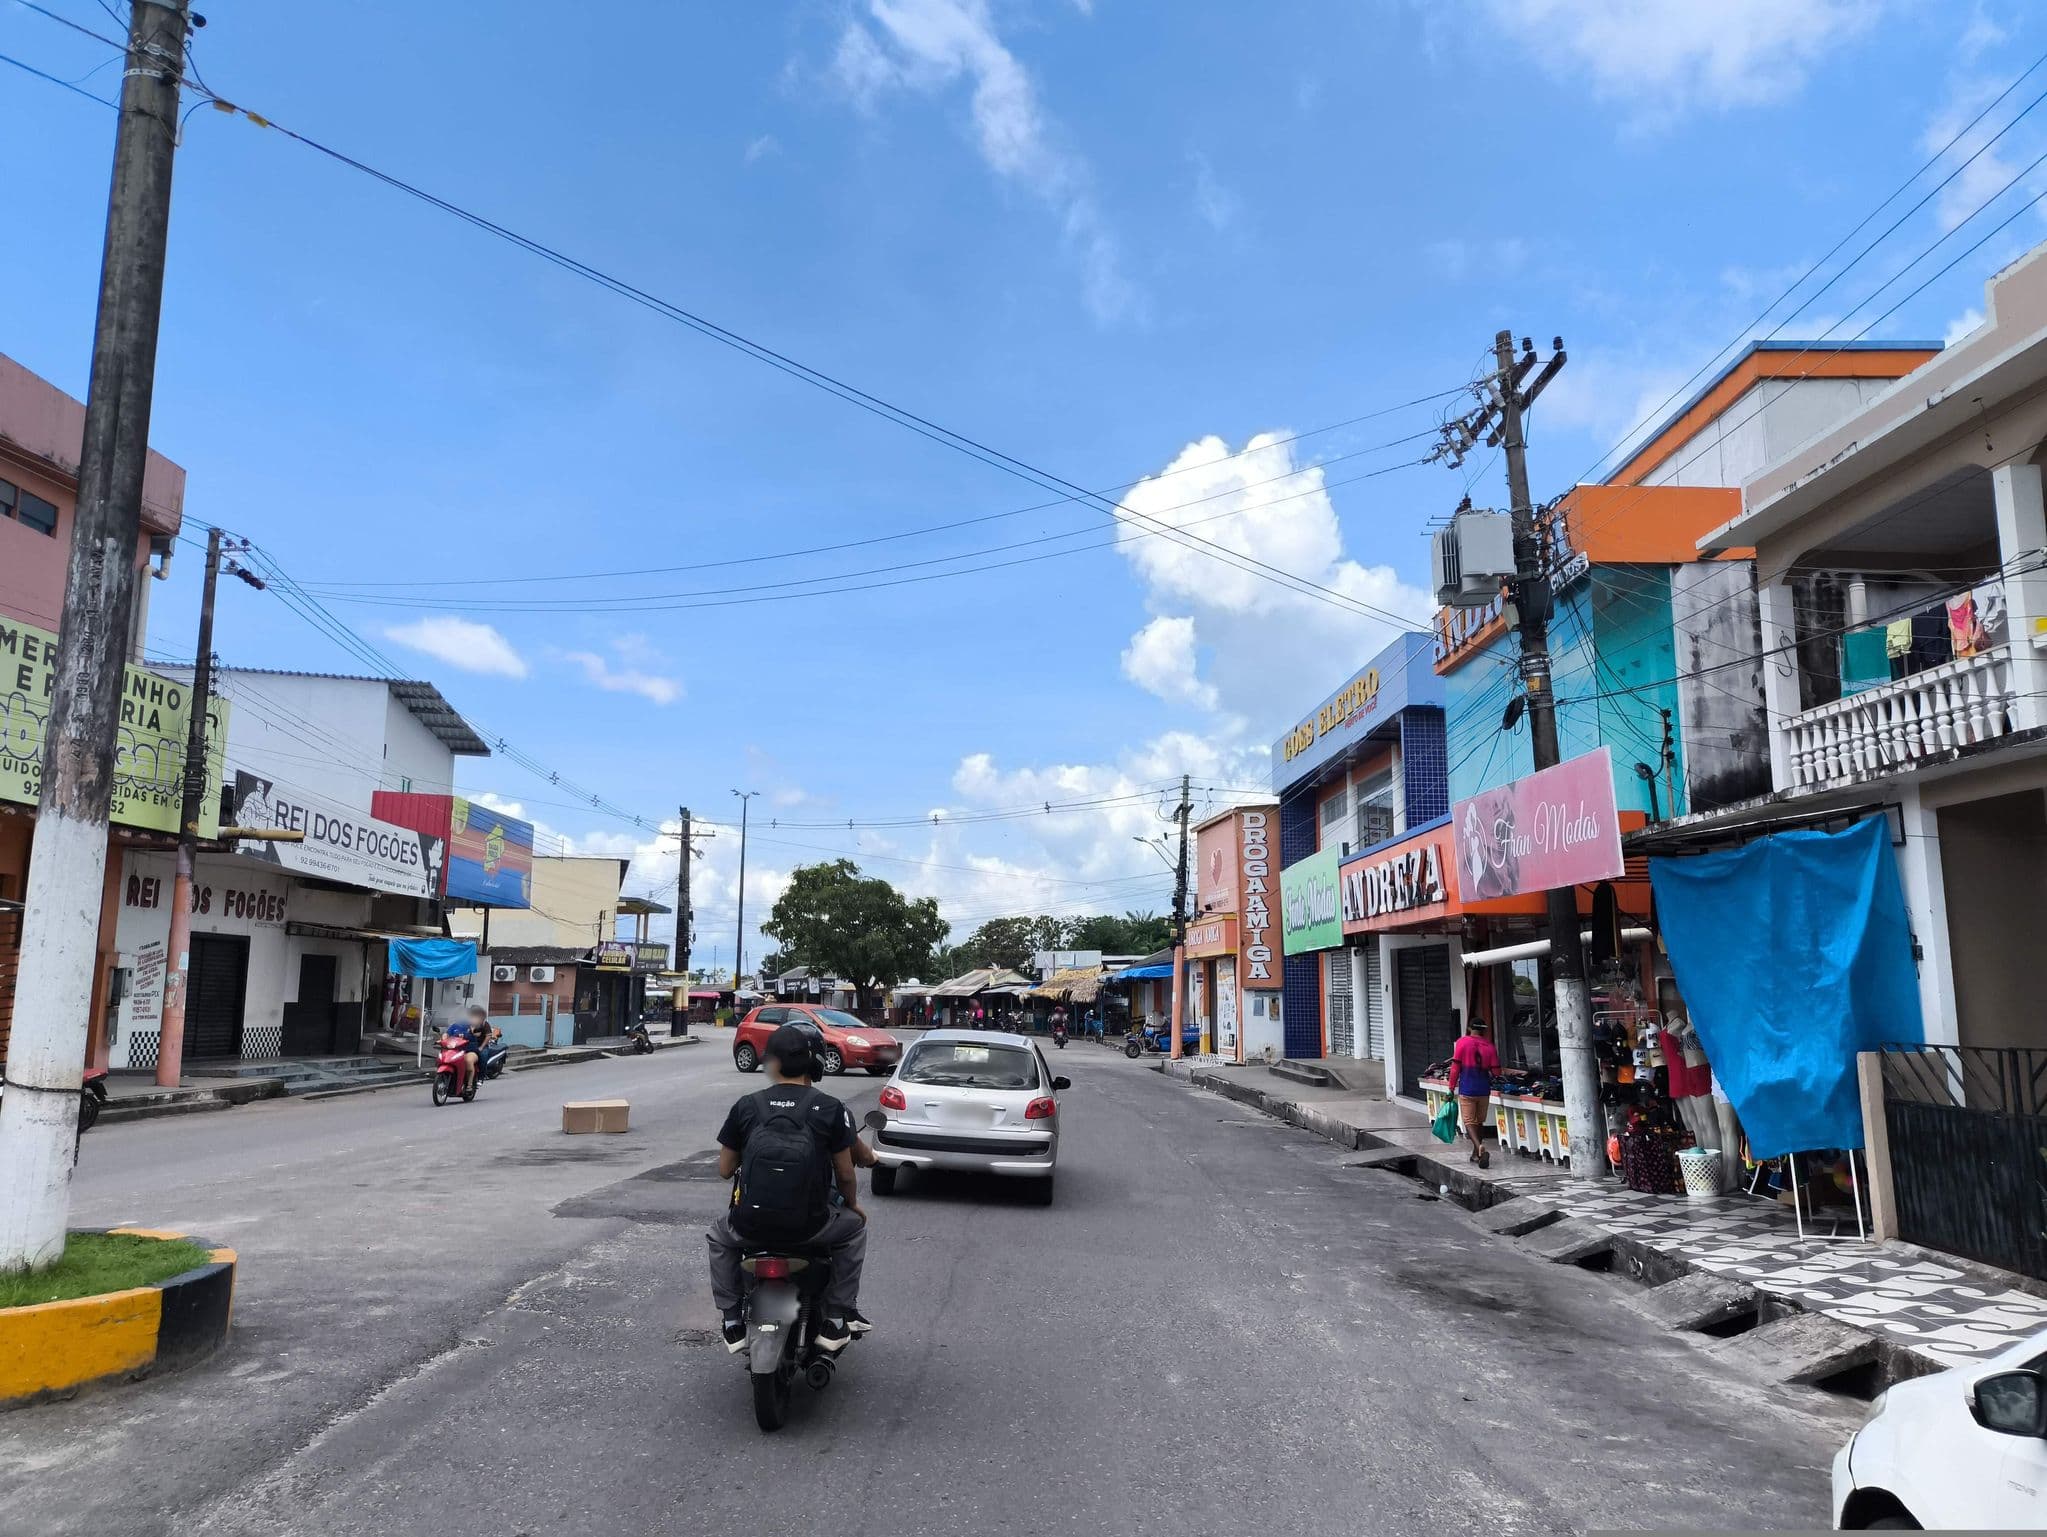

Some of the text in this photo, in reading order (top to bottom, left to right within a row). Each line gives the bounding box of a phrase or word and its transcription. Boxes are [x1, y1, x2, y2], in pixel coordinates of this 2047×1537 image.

[16, 663, 34, 692] E
[1319, 668, 1380, 738] ELETRO
[153, 794, 169, 808] EM
[275, 800, 418, 866] REI DOS FOGÕES
[1490, 800, 1600, 869] Fran Modas
[126, 875, 161, 909] REI
[223, 889, 285, 922] FOGÕES
